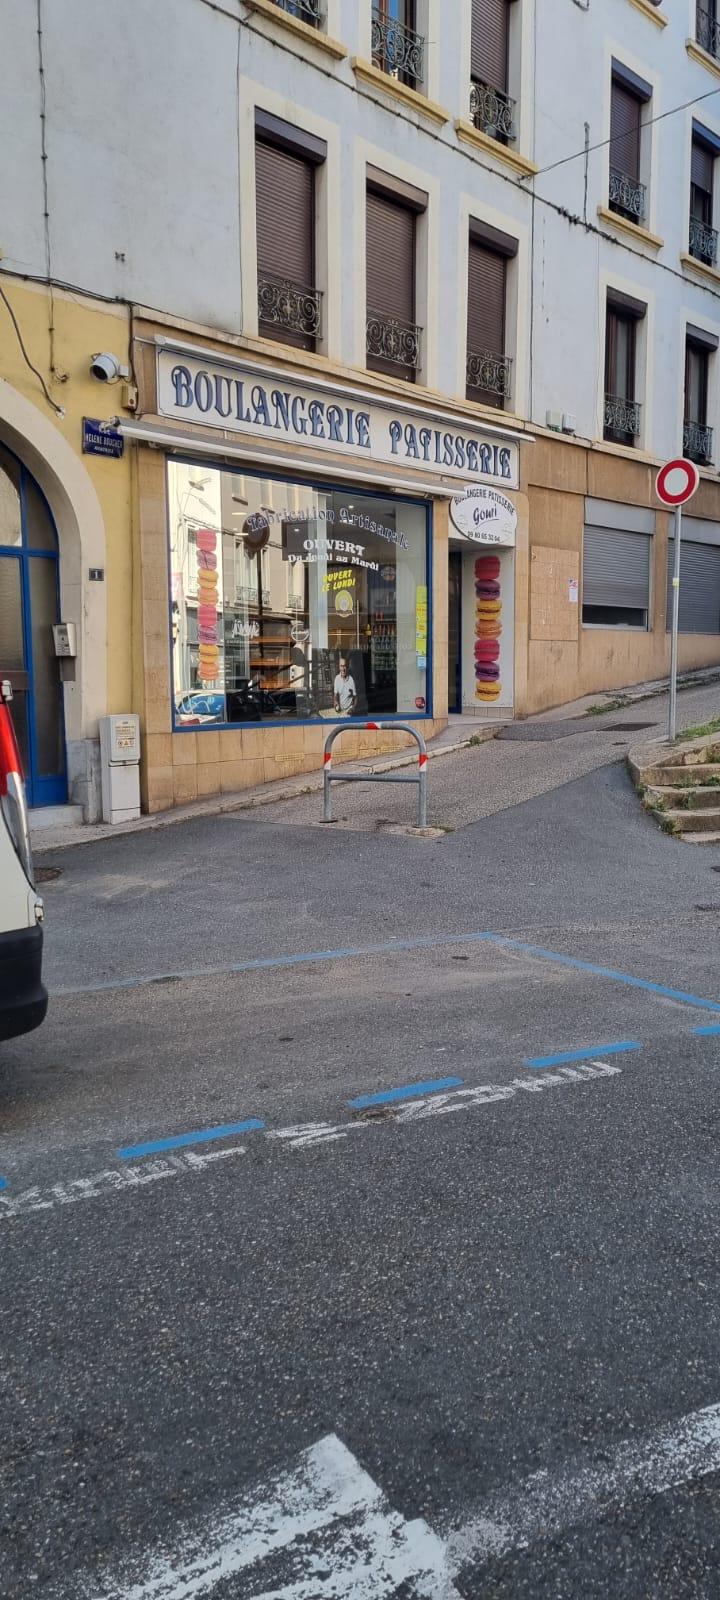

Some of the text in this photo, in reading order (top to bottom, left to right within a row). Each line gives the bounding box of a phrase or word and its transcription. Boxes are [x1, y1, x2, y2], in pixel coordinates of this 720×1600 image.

[170, 365, 512, 479] BOULANGERIE PATISSERIE
[454, 488, 515, 516] BOANGERIE PATISSERIE
[247, 506, 410, 551] Fabrication Artisanale
[303, 538, 365, 557] OUVERT
[287, 553, 303, 563] Du
[335, 555, 349, 563] au
[351, 555, 379, 572] Mardi
[323, 569, 353, 584] OUVERT
[333, 577, 356, 591] LUNDI
